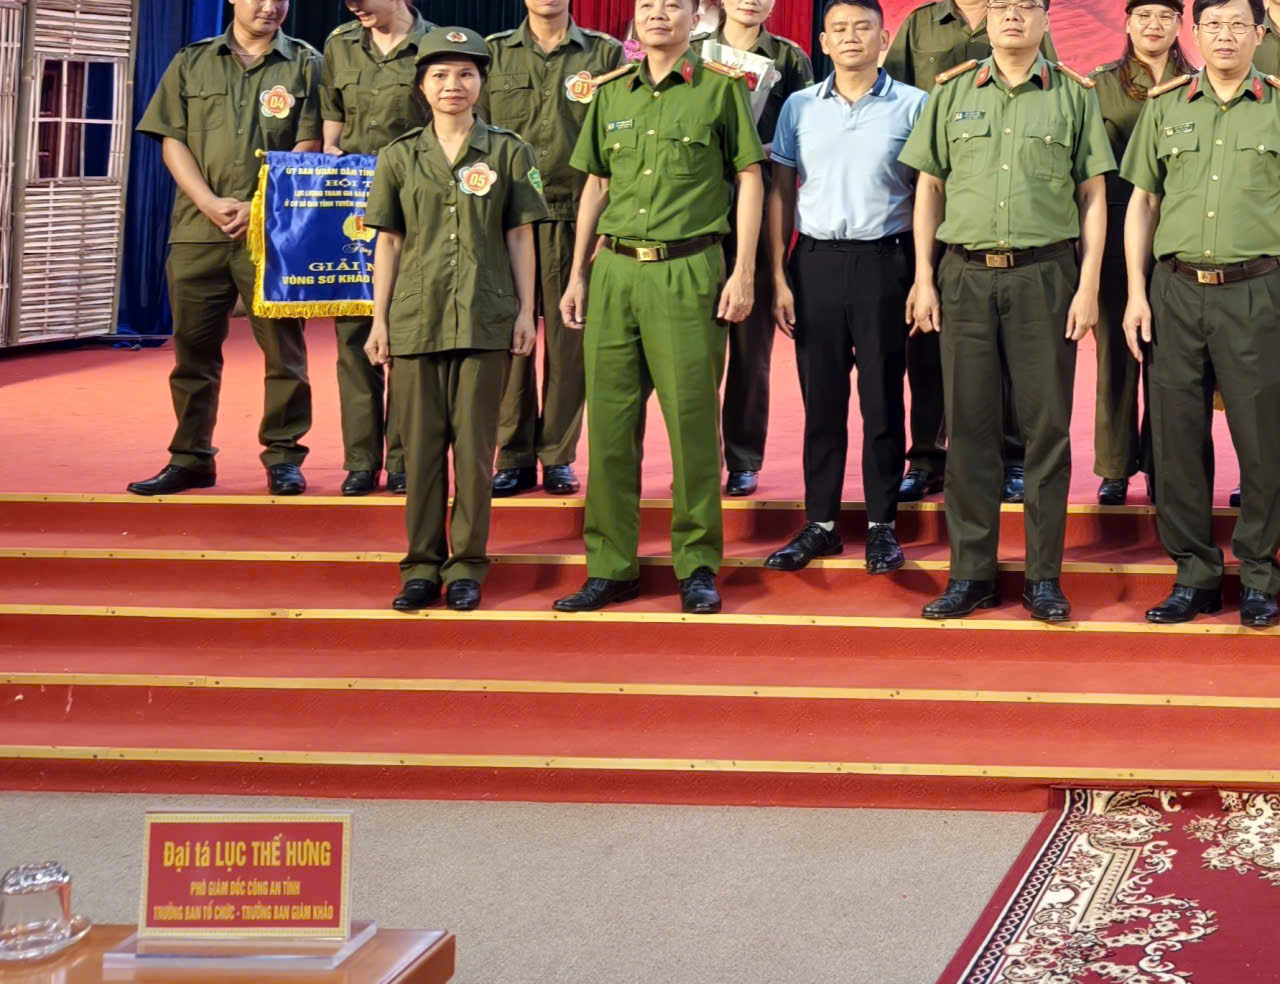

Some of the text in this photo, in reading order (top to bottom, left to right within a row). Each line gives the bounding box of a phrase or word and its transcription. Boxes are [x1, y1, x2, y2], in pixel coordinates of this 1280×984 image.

[270, 95, 285, 109] 04
[470, 172, 486, 187] 05
[163, 832, 332, 872] Đại tá LỤC THẾ HƯNG
